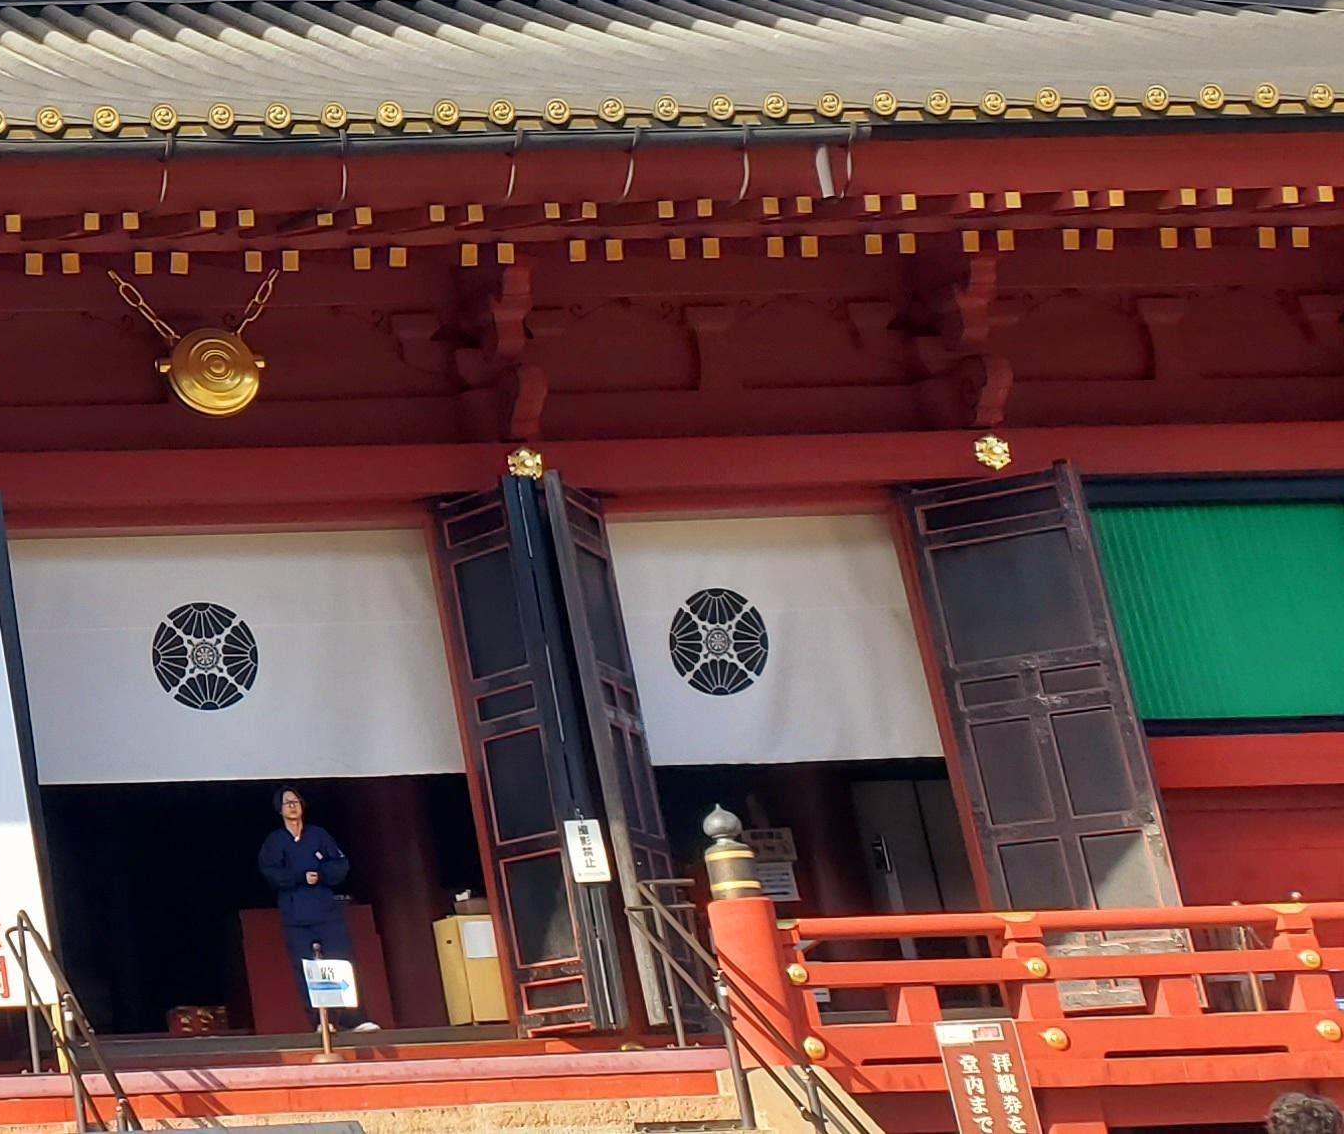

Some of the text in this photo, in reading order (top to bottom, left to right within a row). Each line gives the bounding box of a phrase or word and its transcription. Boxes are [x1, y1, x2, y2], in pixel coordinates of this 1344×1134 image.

[958, 1053, 994, 1134] 堂内まで
[991, 1052, 1027, 1134] 拝観券を
